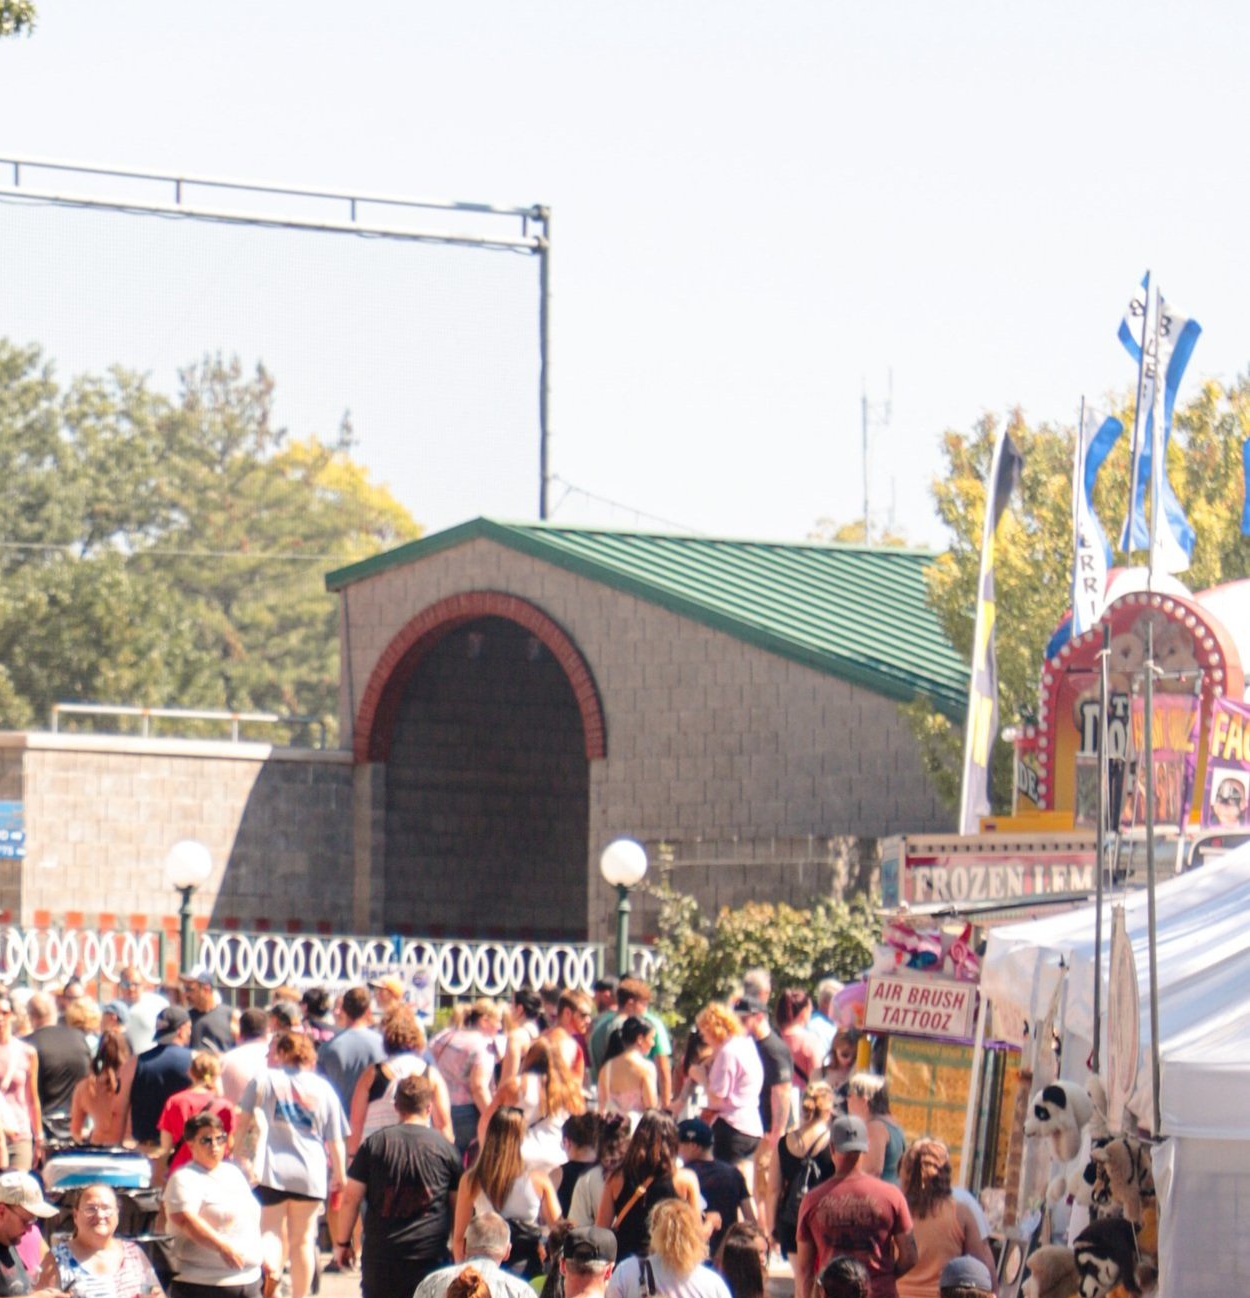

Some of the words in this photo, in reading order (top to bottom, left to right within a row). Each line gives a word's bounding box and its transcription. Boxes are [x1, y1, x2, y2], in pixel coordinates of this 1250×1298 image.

[914, 865, 1026, 901] FROZEN
[873, 982, 904, 1001] AIR
[907, 984, 967, 1012] BRUSH
[881, 1005, 953, 1032] TATTOOZ
